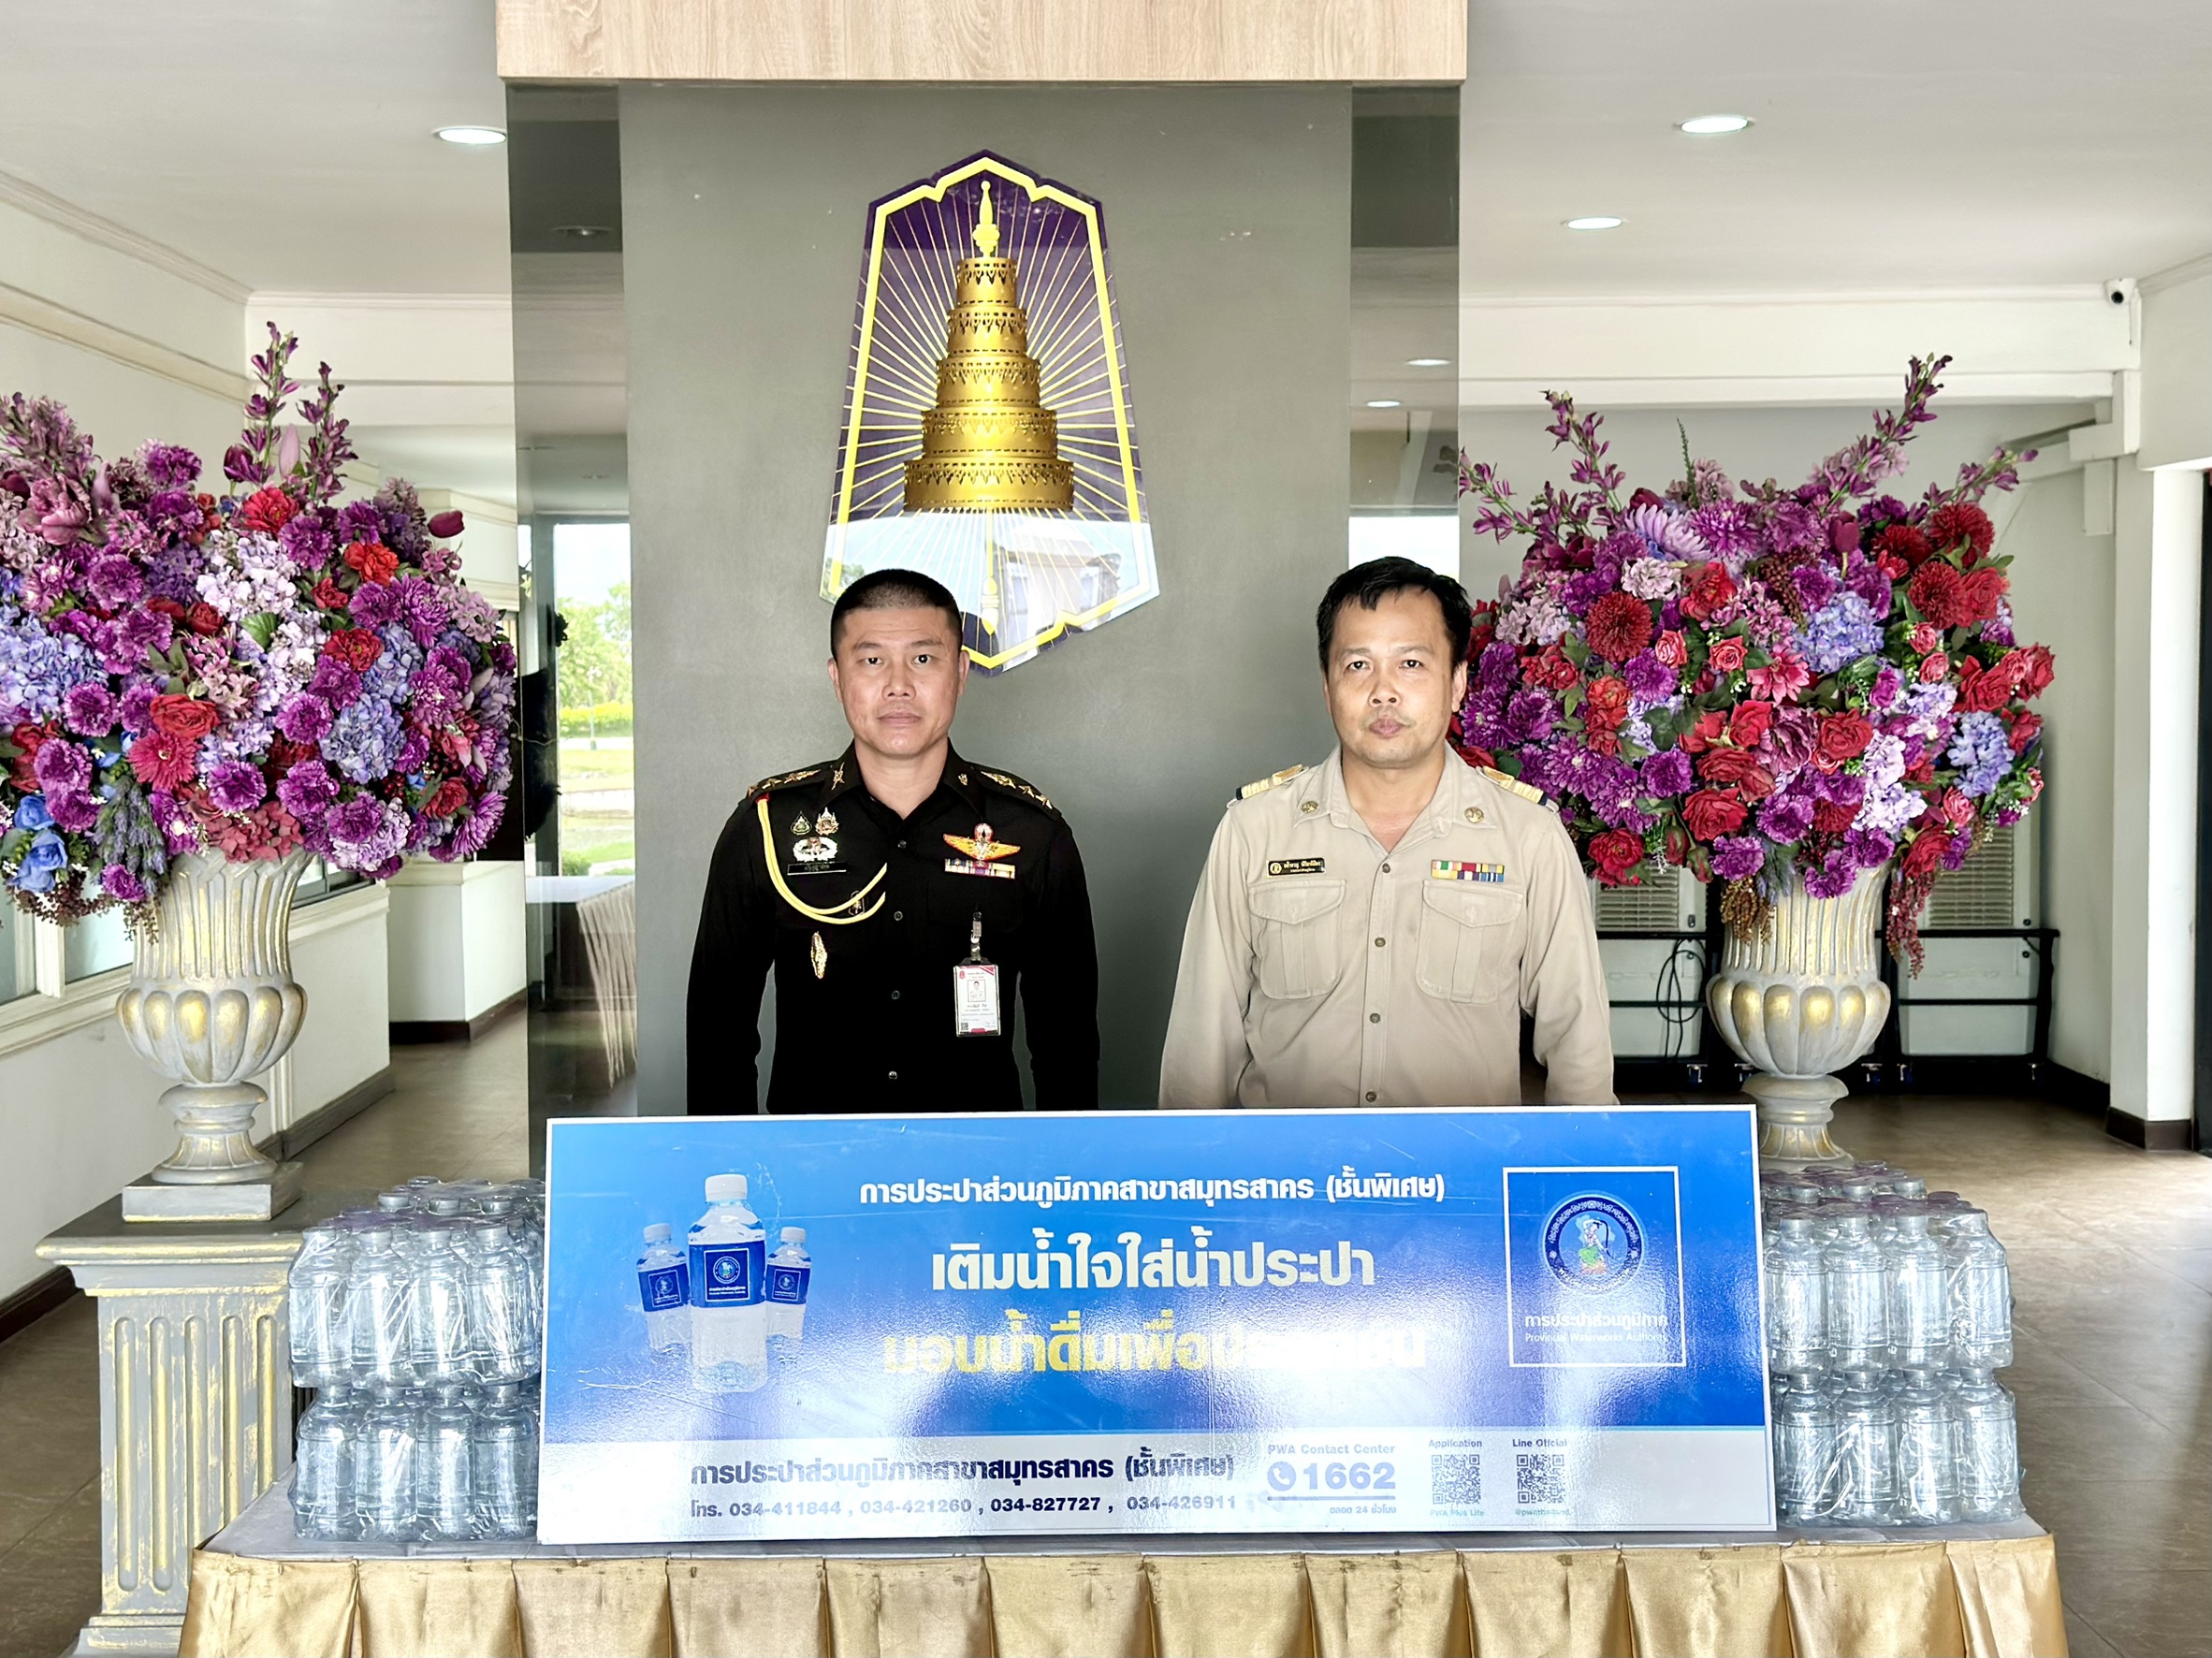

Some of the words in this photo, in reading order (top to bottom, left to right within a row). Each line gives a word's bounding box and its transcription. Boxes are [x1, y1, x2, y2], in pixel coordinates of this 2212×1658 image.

[859, 1174, 1315, 1209] การประปาส่วนภูมิภาคสาขาสมุทรสาคร
[1325, 1164, 1446, 1204] (ชั้นพิเศษ)
[932, 1225, 1375, 1290] เติมน้ำใจใส่น้ำประปา
[1267, 1444, 1296, 1454] PWA
[1301, 1444, 1349, 1454] Contact
[1354, 1444, 1396, 1454] Center
[1428, 1439, 1483, 1449] Application
[1512, 1438, 1533, 1447] Line
[691, 1457, 1114, 1488] การประปาส่วนภูมิภาคสาขาสมุทรสาคร
[1125, 1446, 1234, 1482] (ชั้นพิเศษ)
[1302, 1462, 1396, 1490] 1662
[729, 1500, 842, 1518] 034-411844
[860, 1499, 972, 1515] 034-421260
[990, 1497, 1101, 1512] 034-827727
[1127, 1494, 1236, 1511] 034-426911
[1355, 1505, 1368, 1514] 24
